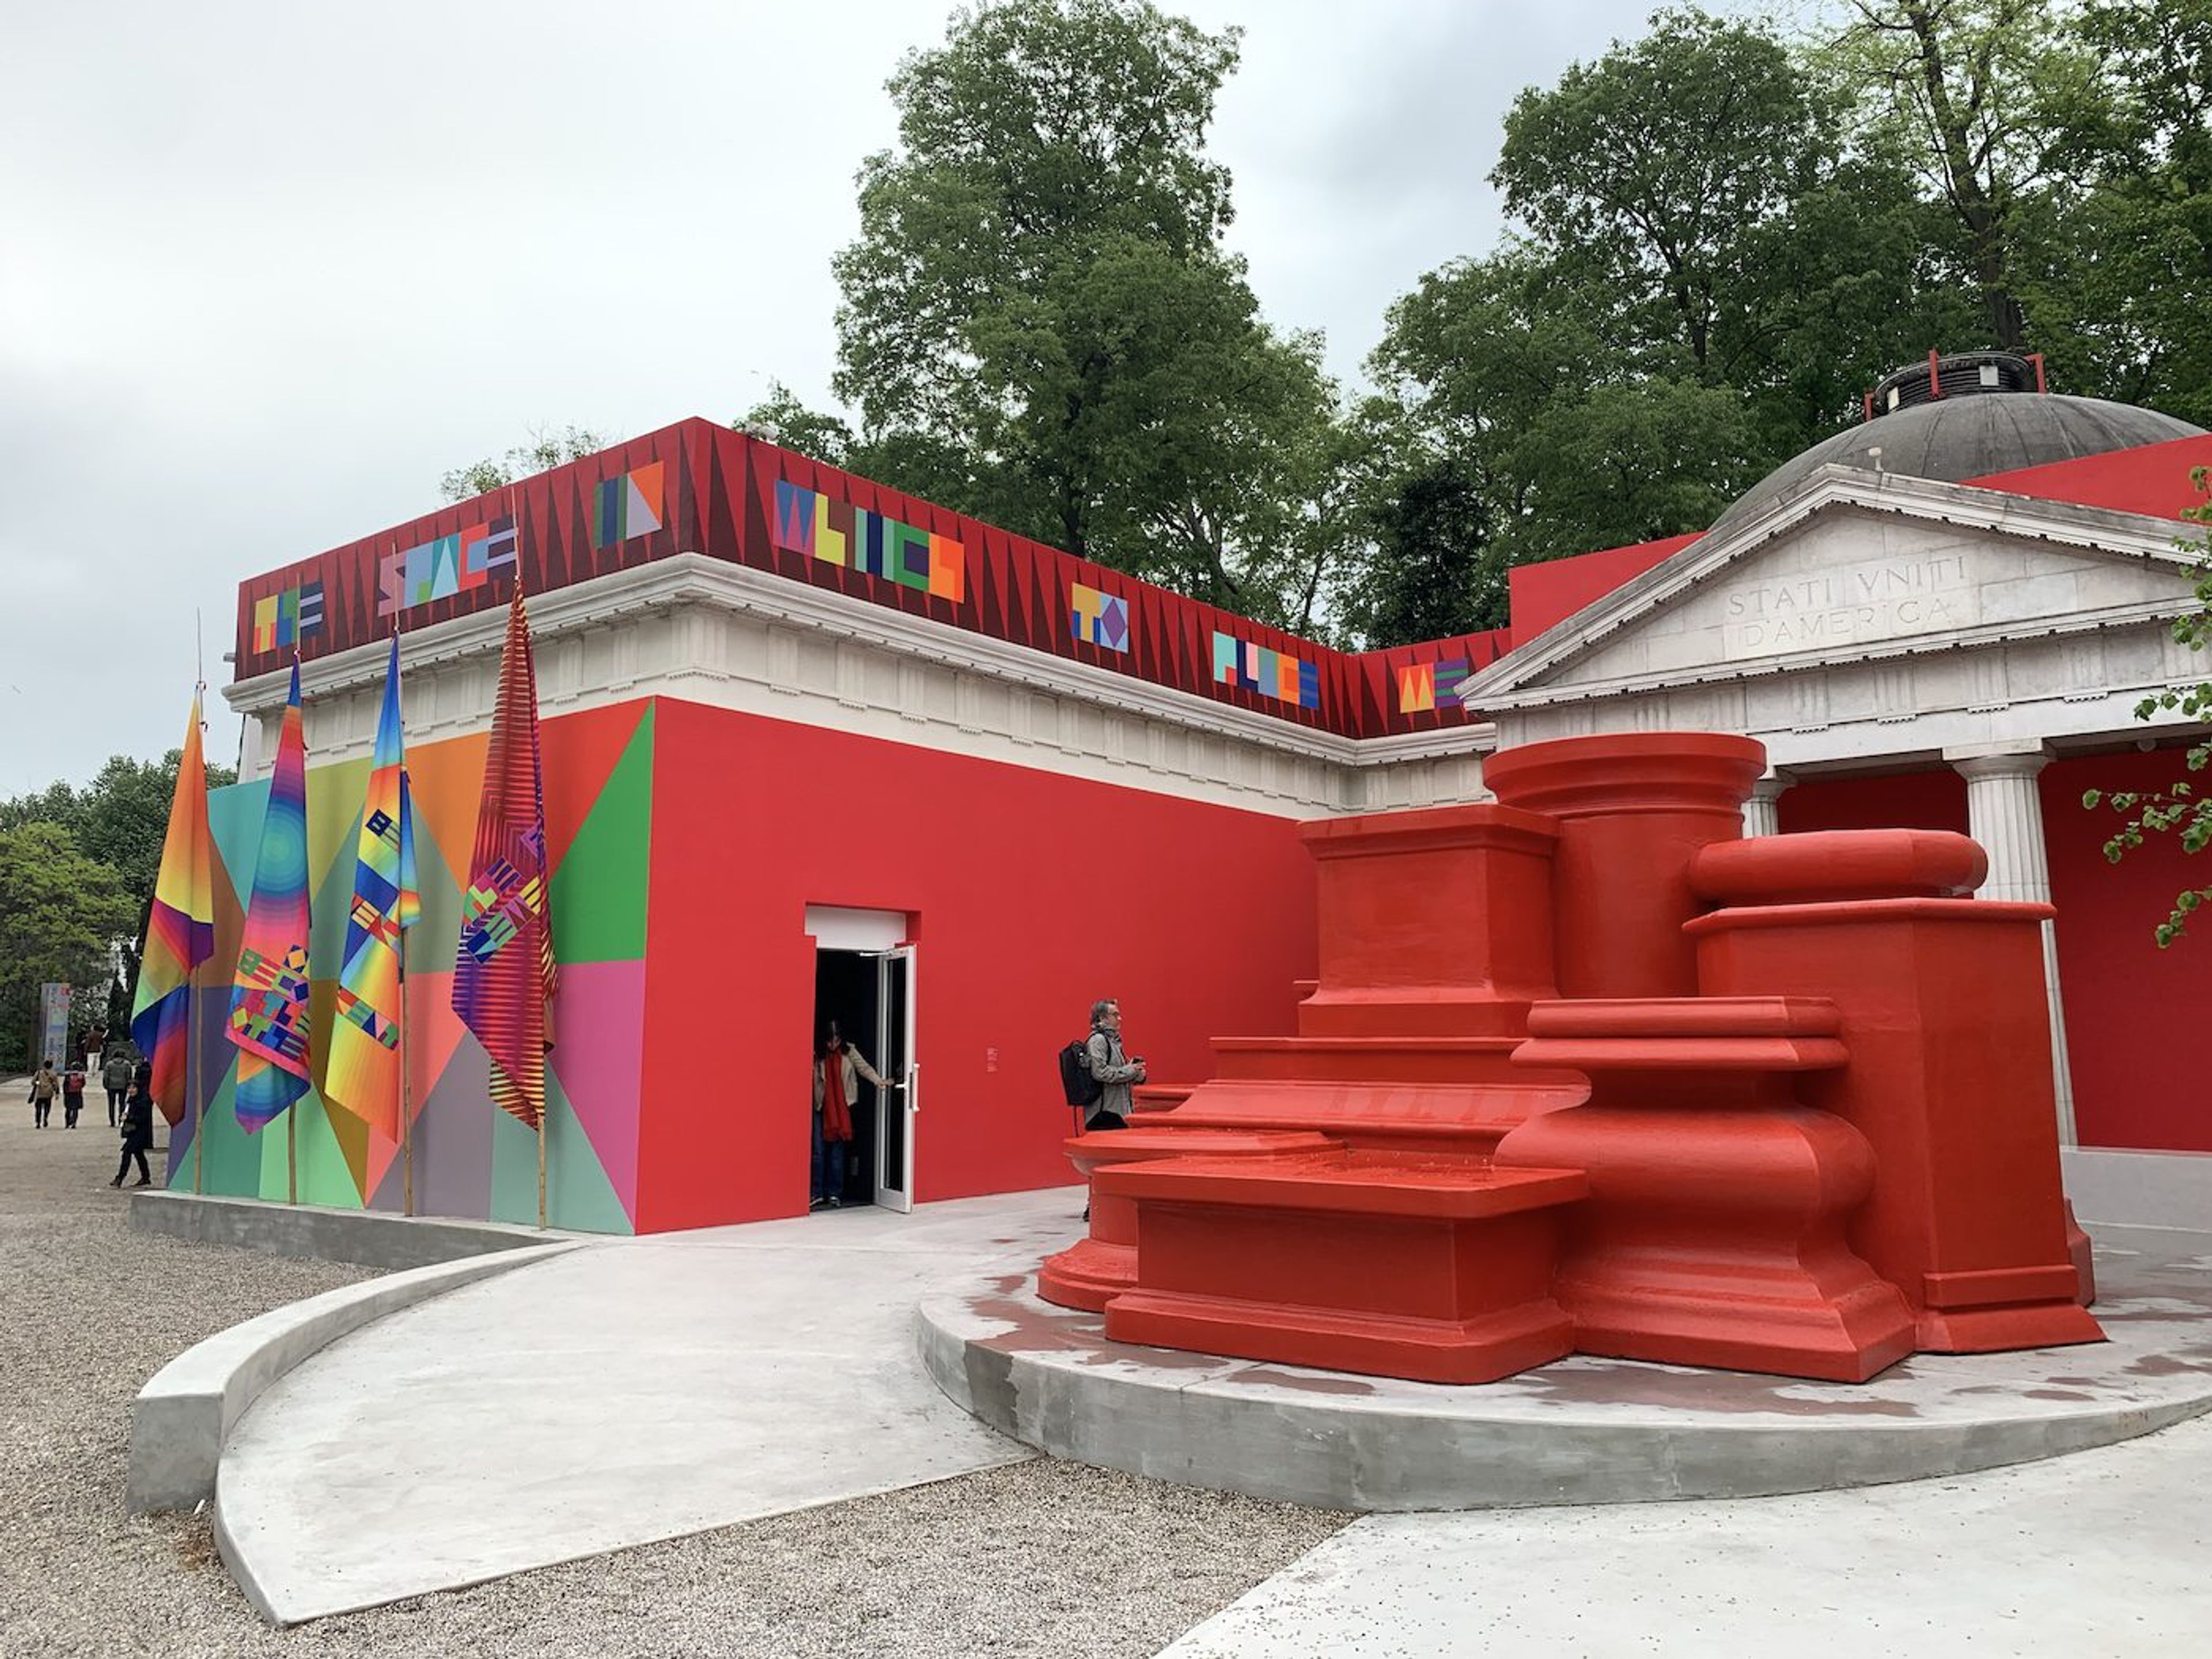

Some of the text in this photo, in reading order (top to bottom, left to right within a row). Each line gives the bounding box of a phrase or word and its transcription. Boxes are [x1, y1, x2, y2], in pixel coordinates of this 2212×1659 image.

[1072, 582, 1128, 653] TO
[1730, 556, 1963, 616] STATI VNITI
